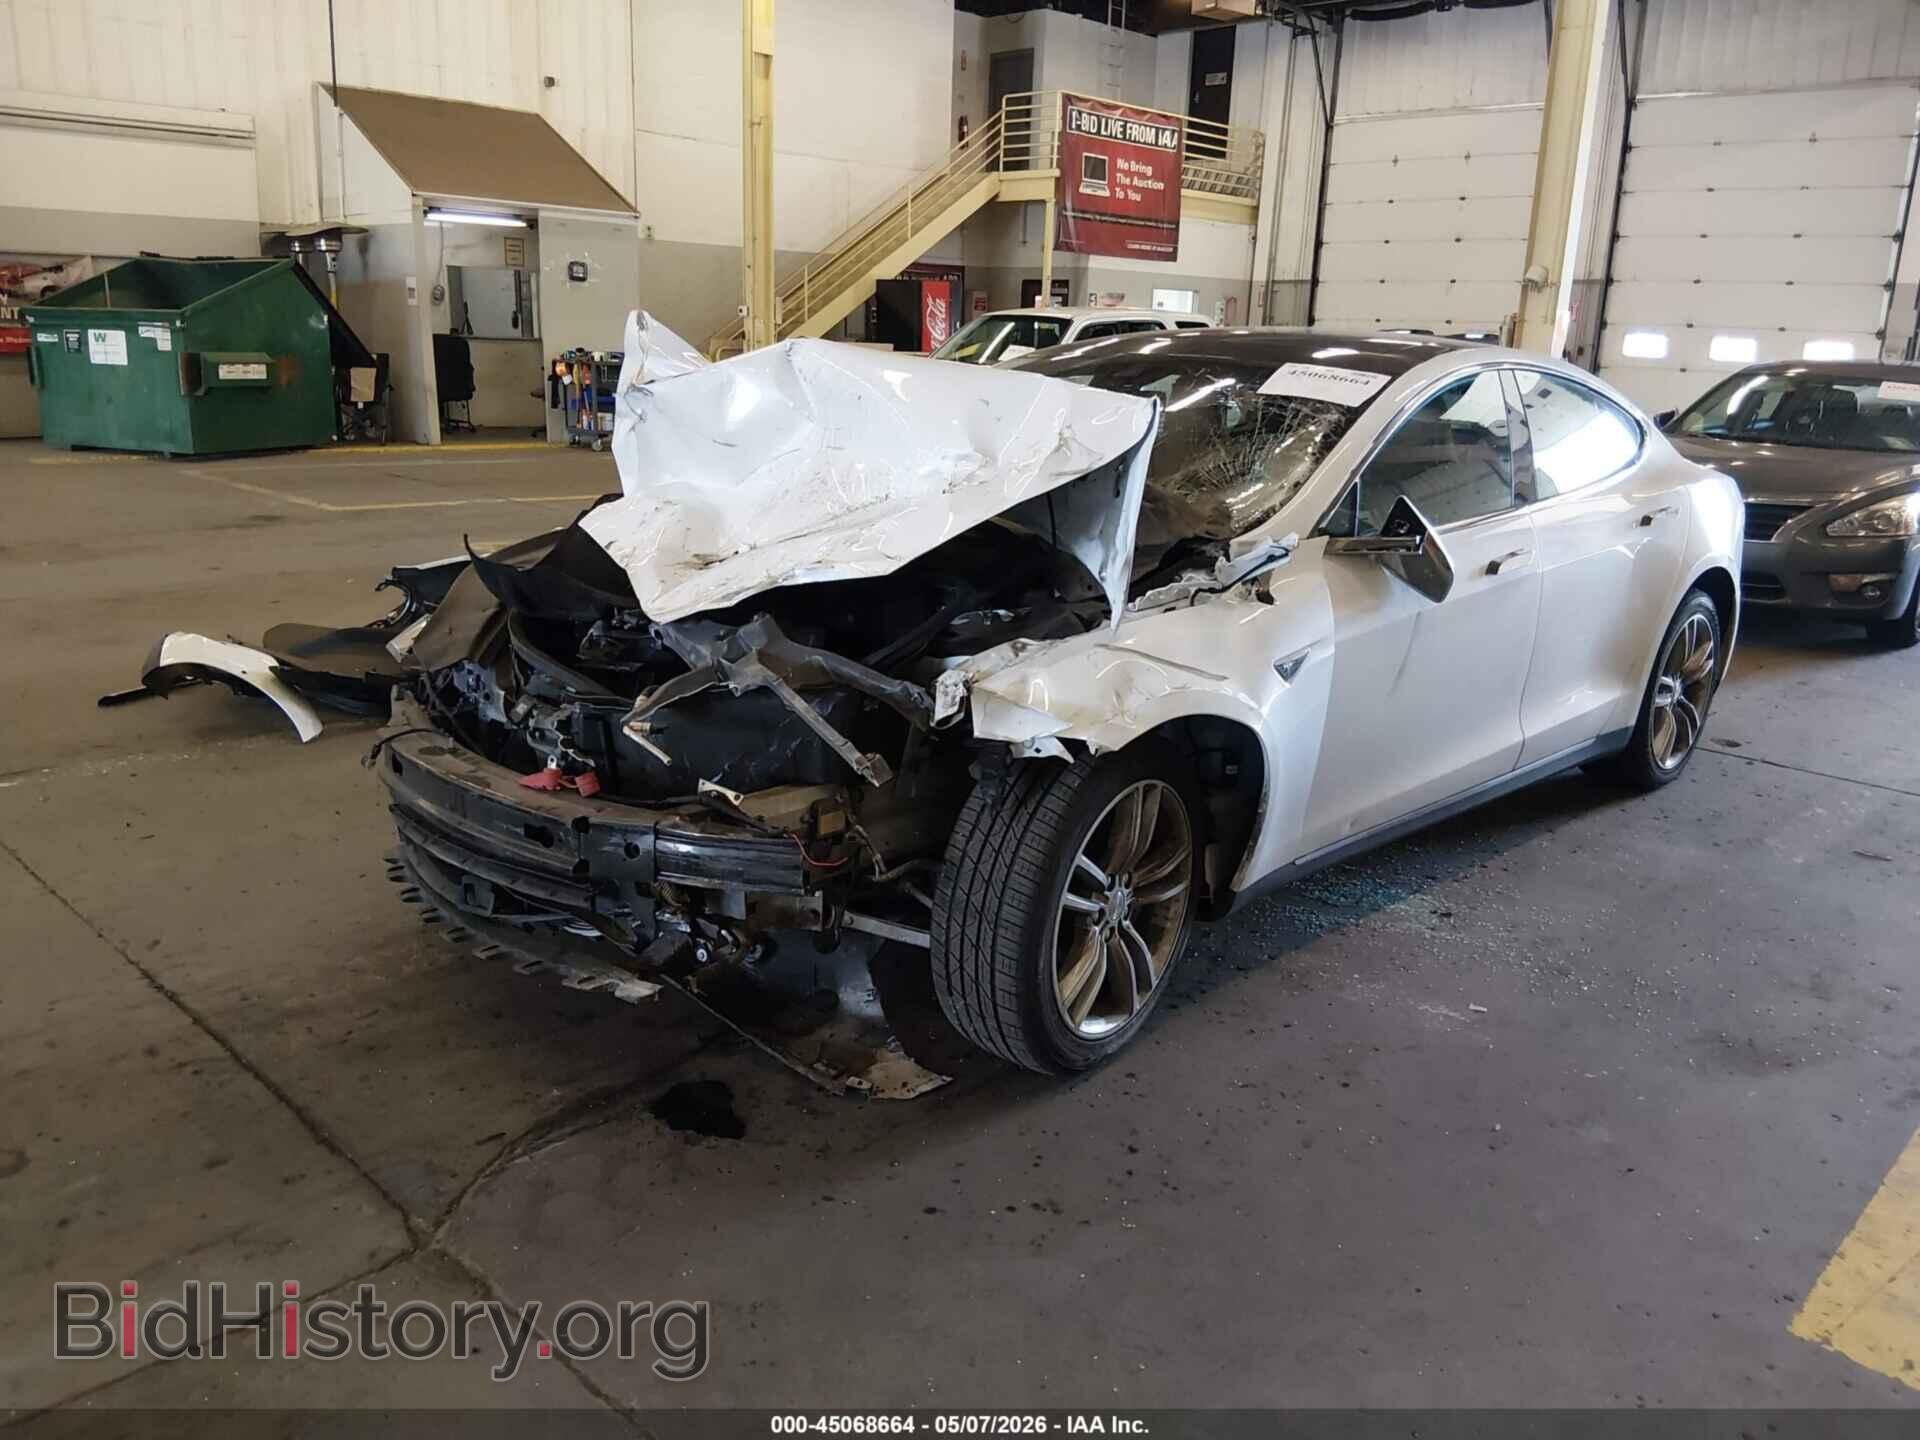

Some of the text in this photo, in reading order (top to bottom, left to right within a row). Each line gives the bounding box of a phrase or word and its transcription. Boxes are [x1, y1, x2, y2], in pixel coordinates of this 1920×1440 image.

[1100, 116, 1126, 138] LIVE
[1126, 123, 1156, 145] FROM
[1130, 160, 1152, 176] Bring
[1116, 173, 1165, 190] The Auction
[1115, 187, 1141, 202] To You
